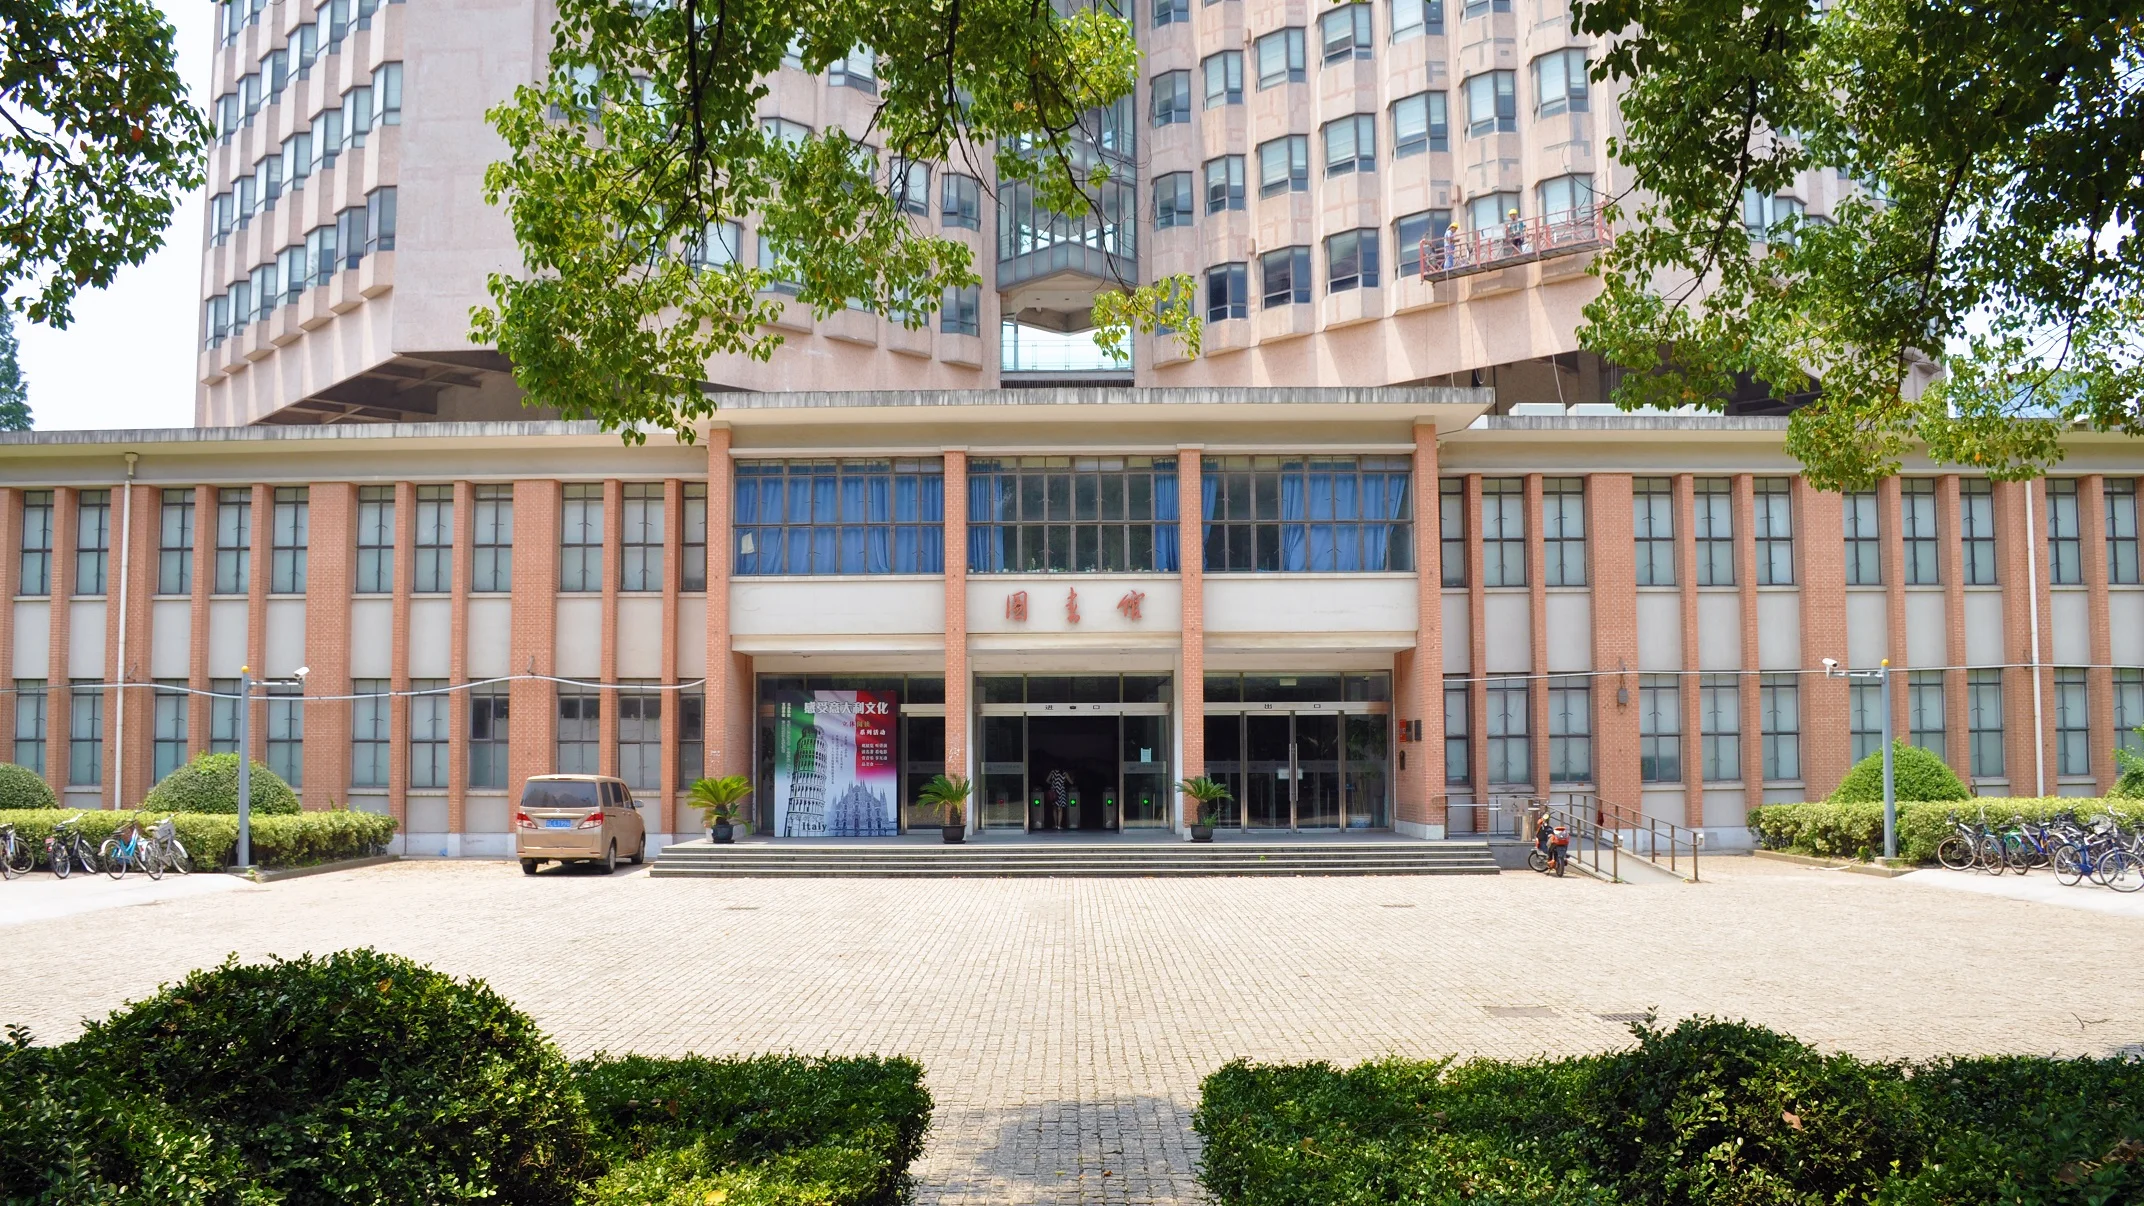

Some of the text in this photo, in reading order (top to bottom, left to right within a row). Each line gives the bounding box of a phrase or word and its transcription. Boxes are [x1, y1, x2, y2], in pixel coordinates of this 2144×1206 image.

[804, 702, 888, 714] 感受意大利文化
[803, 822, 827, 832] Italy
